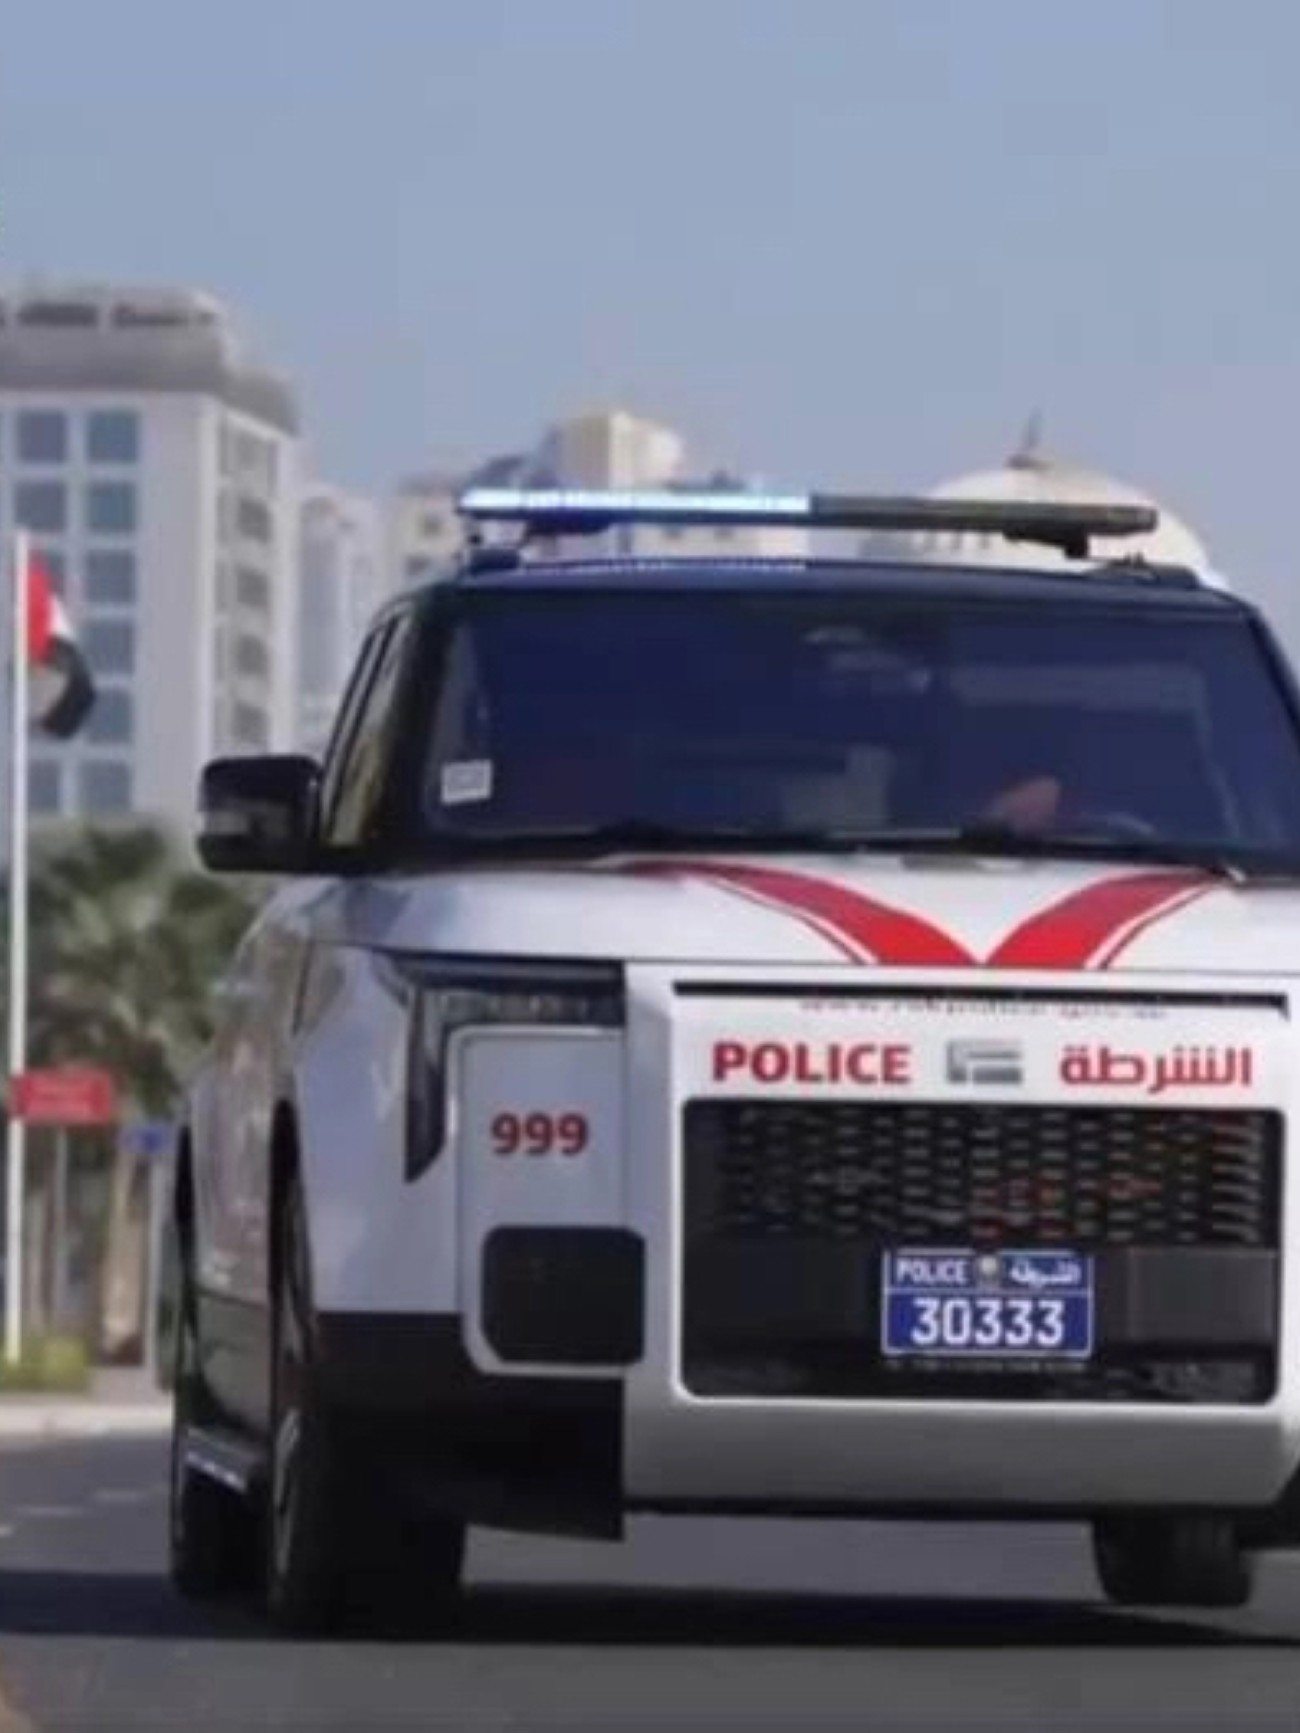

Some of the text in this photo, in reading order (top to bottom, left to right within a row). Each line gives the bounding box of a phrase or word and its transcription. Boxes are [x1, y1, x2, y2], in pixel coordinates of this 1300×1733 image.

[712, 1041, 913, 1084] POLICE
[1060, 1044, 1251, 1094] الشرطة
[491, 1110, 589, 1157] 999
[897, 1257, 970, 1284] POLICE
[911, 1297, 1065, 1347] 30333
